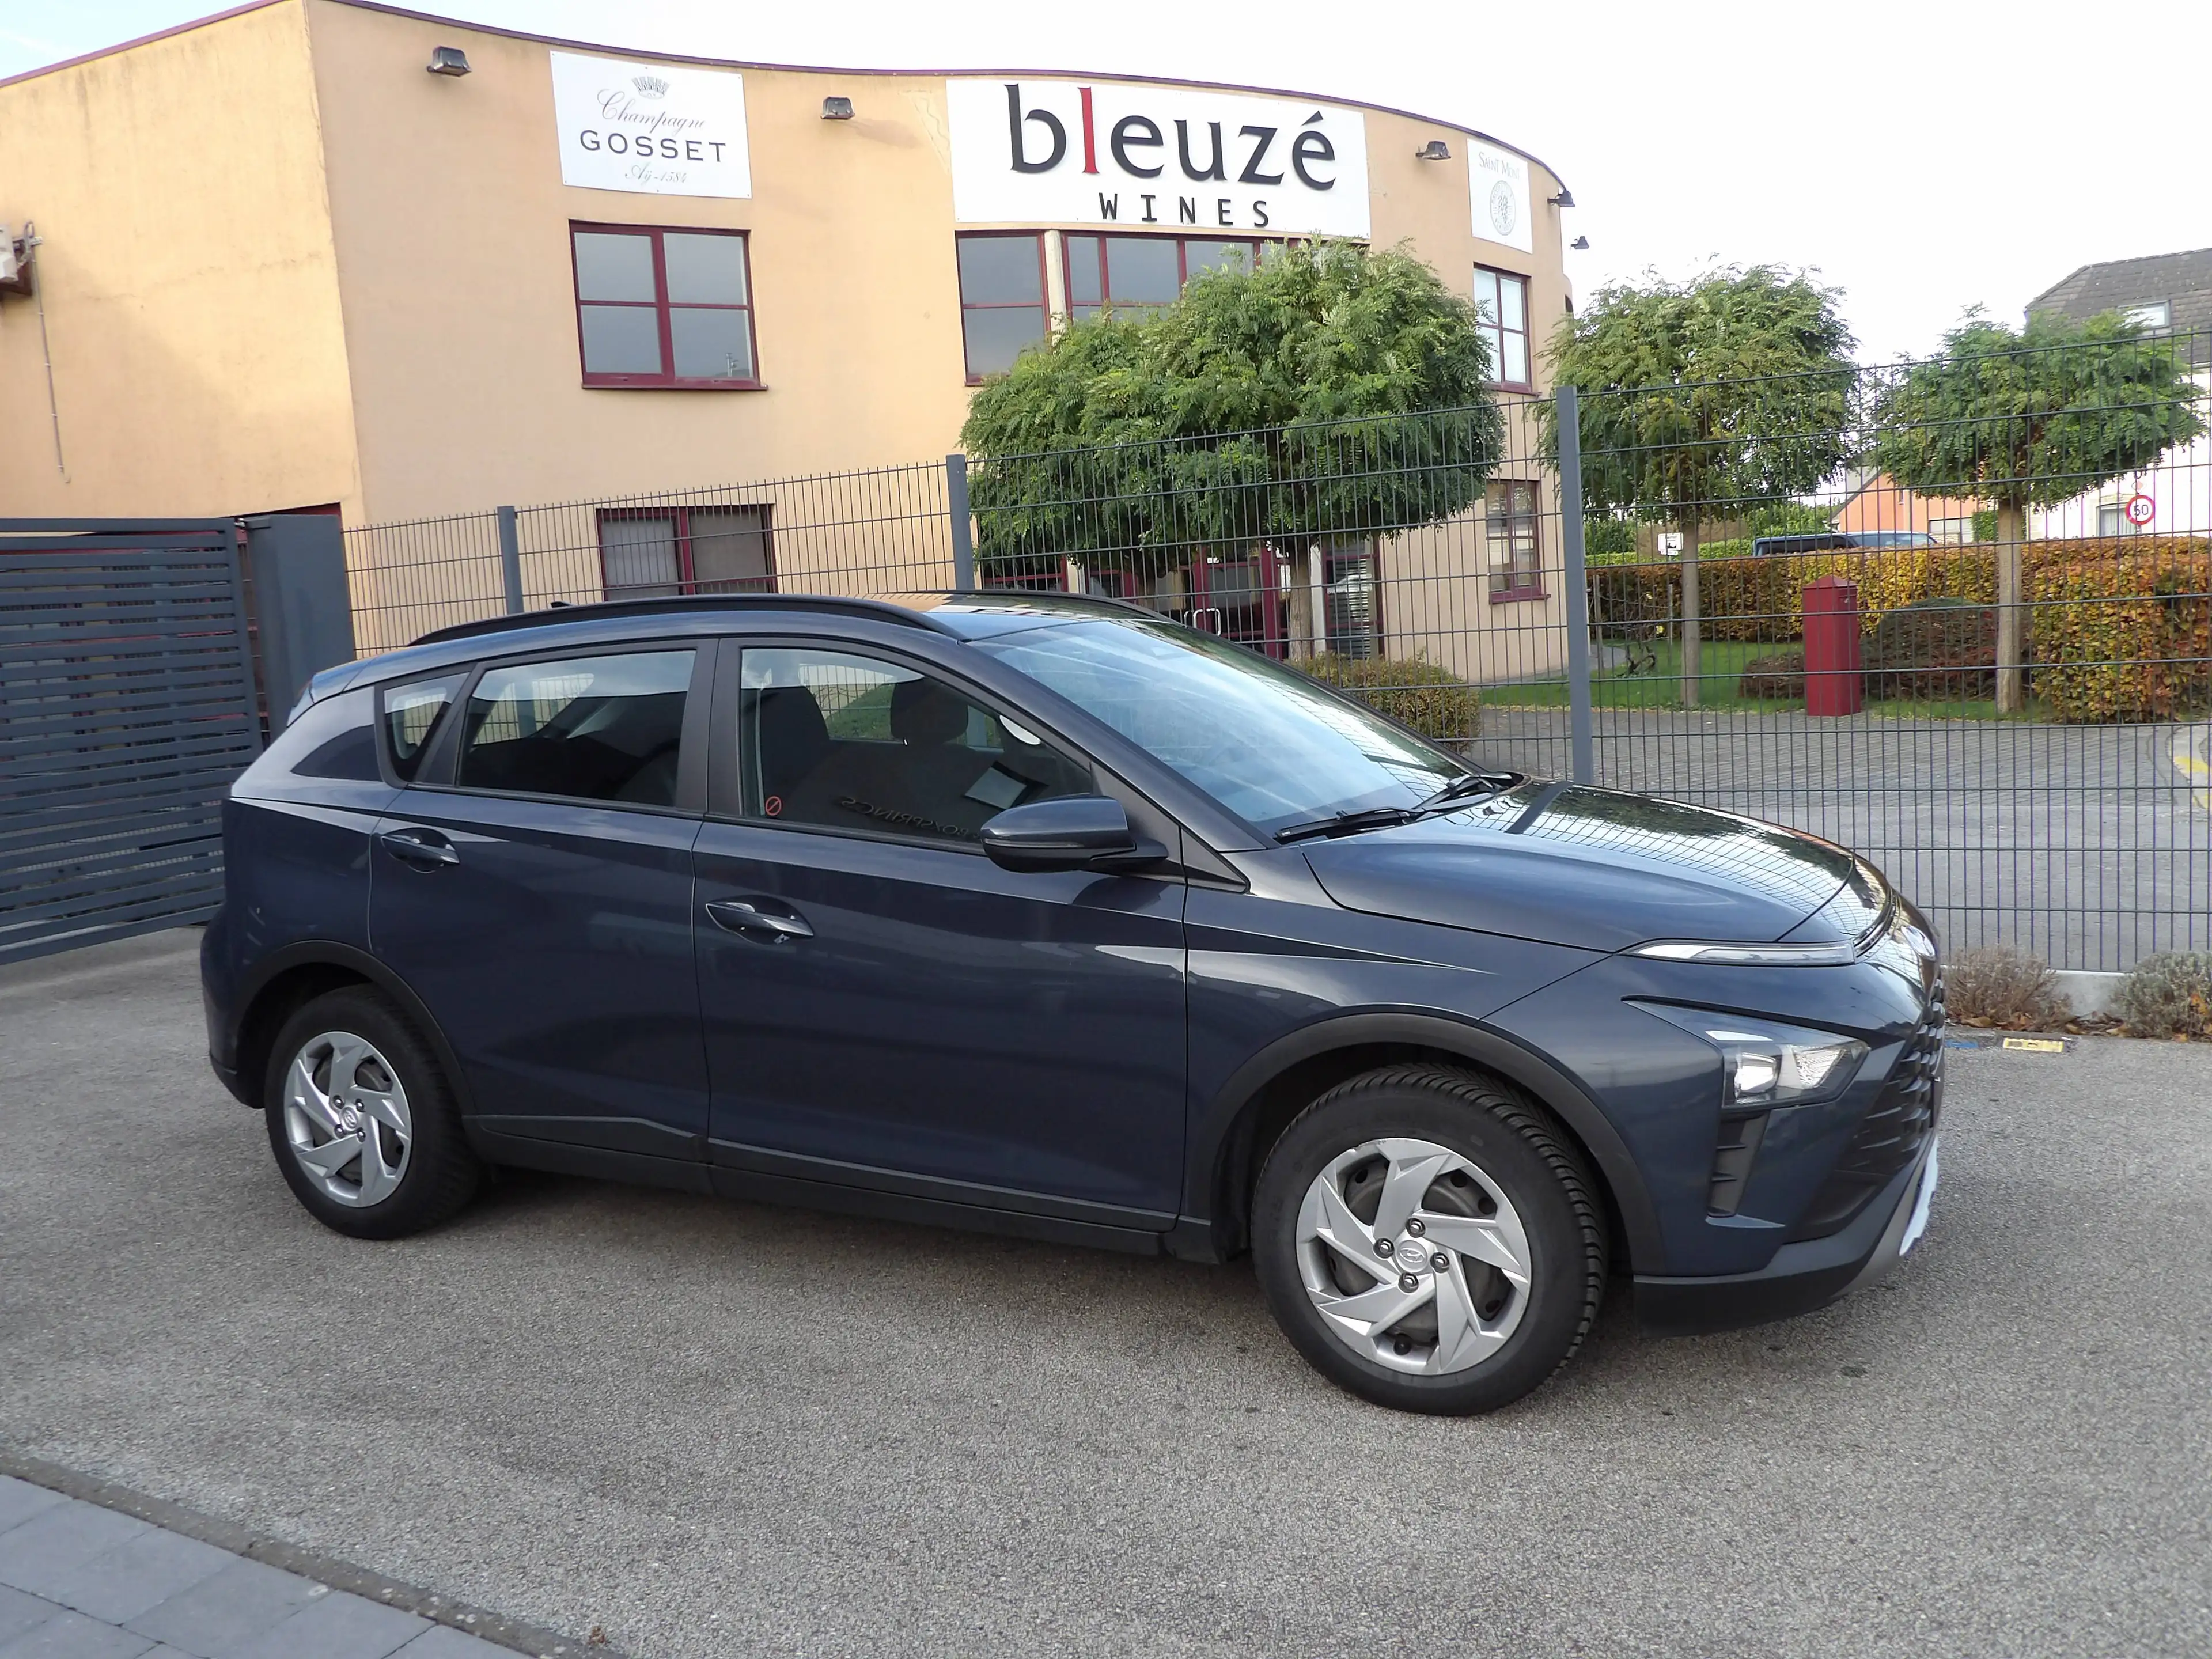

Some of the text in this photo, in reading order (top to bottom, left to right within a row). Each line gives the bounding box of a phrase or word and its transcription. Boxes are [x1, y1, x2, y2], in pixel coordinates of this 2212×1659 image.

[597, 88, 707, 136] Champagne
[579, 129, 726, 163] GOSSET
[1004, 83, 1337, 191] bleuzé
[1098, 192, 1270, 228] WINES
[2133, 504, 2149, 517] 50
